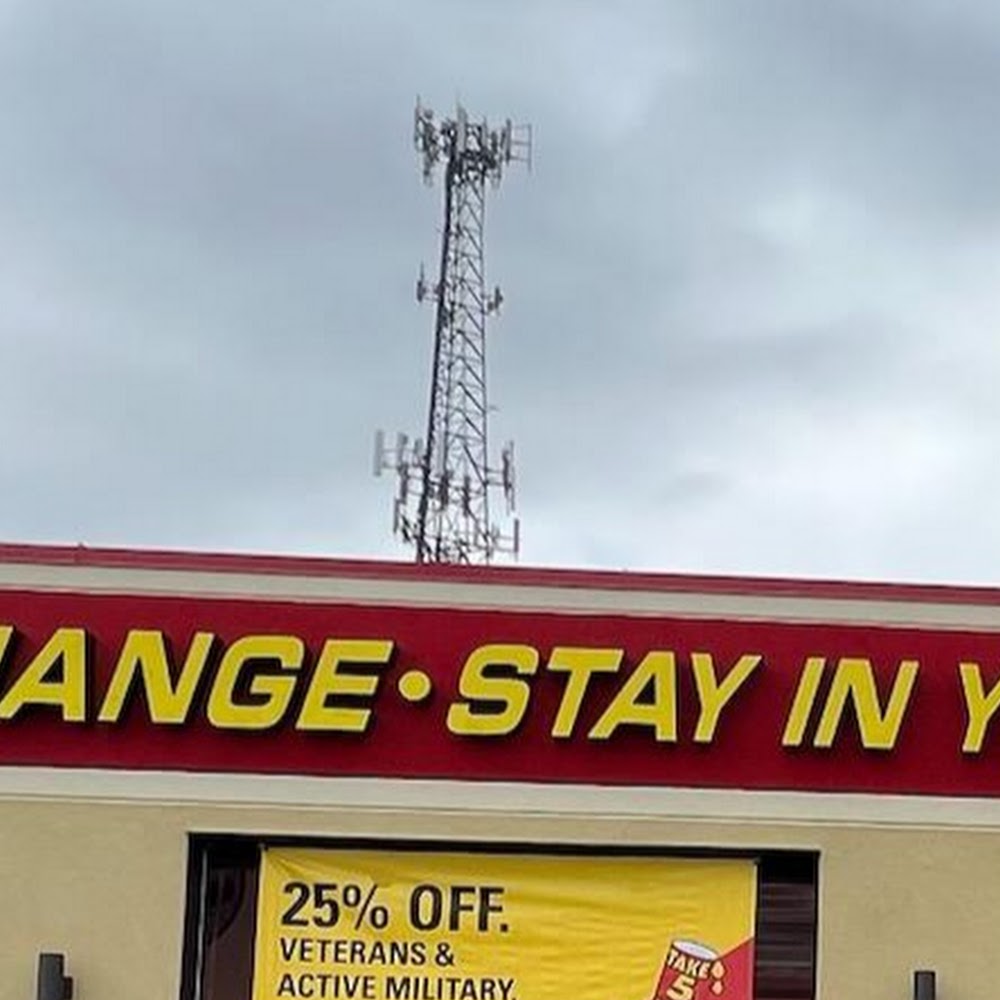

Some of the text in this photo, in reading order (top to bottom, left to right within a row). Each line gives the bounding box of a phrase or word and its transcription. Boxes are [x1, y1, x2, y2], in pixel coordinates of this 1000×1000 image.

[0, 625, 394, 732] ANGE
[446, 643, 763, 742] STAY
[781, 656, 920, 750] IN
[280, 881, 510, 933] 25% OFF.
[279, 937, 455, 967] VETERANS &
[667, 948, 712, 979] TAKE
[277, 973, 377, 1000] ACTIVE
